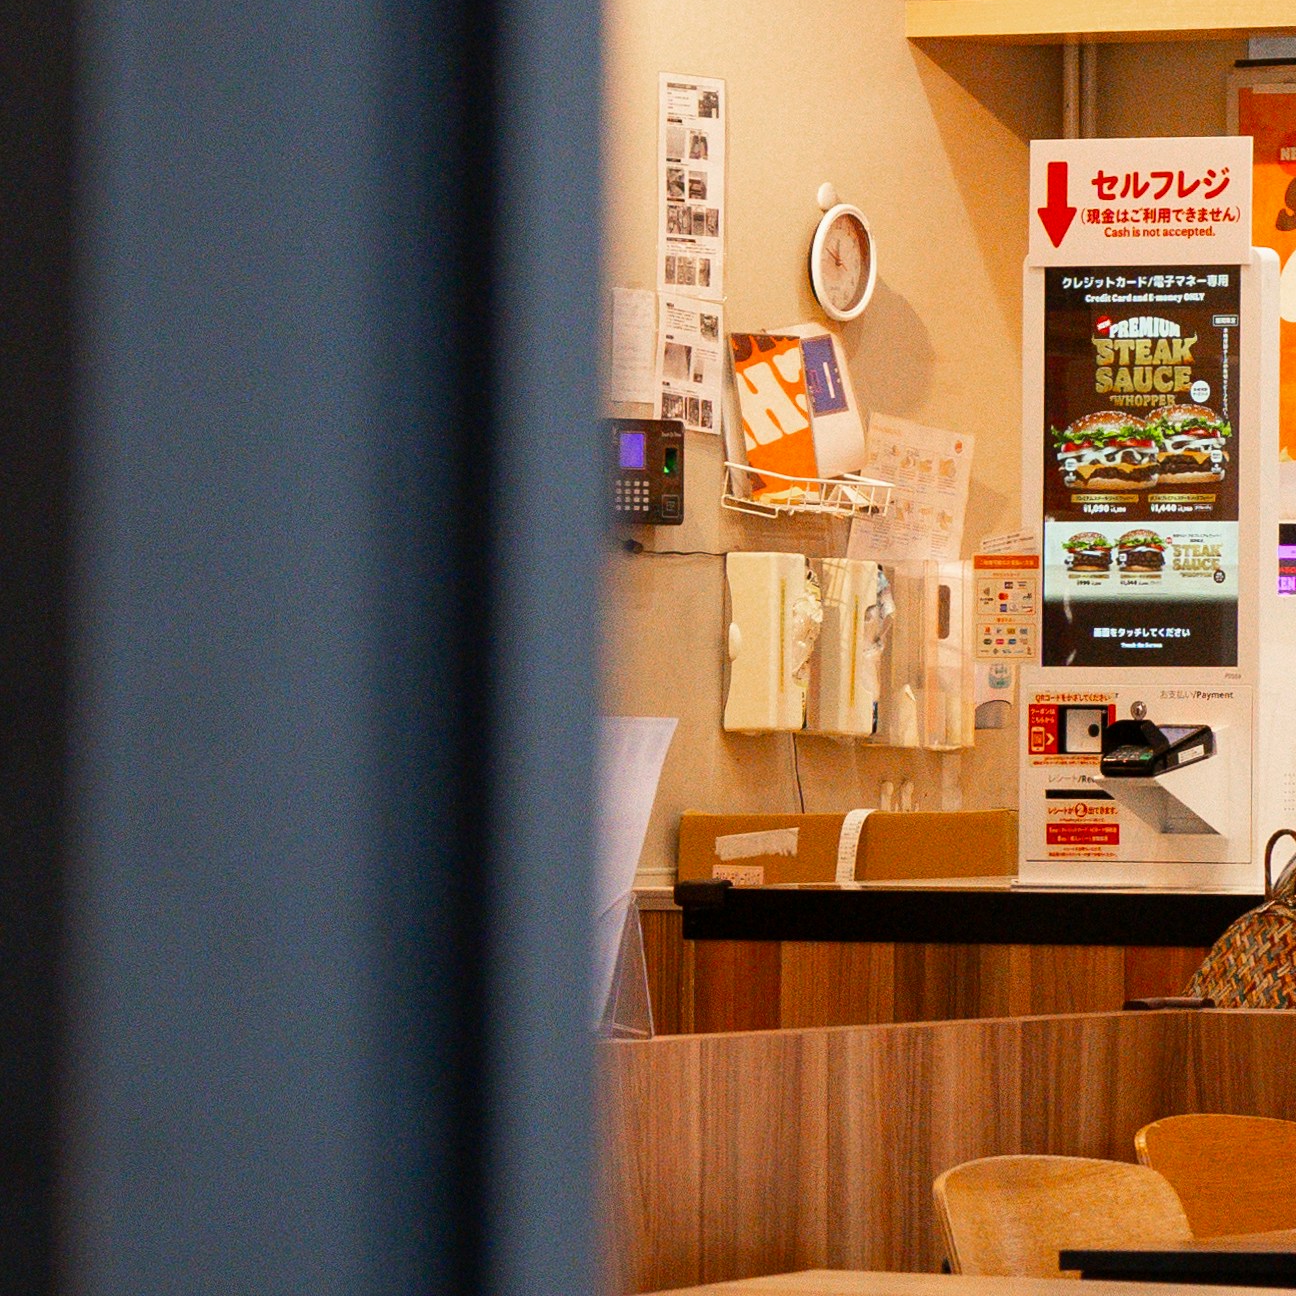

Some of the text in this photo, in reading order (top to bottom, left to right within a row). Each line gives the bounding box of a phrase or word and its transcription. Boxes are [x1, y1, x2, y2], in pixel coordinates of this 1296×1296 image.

[1091, 166, 1231, 201] セルフレジ
[1080, 206, 1241, 224] (現金はご利用できません)
[1104, 226, 1216, 239] Cash is not accepted.
[1061, 274, 1230, 290] クレジットカード/電子マネー専用
[1084, 293, 1111, 303] Credit
[1111, 293, 1132, 303] Card
[1108, 316, 1181, 339] PREMIUM
[1091, 331, 1199, 365] STEAK
[1095, 366, 1193, 394] SAUCE
[1109, 394, 1176, 406] WHOPPER
[1171, 544, 1223, 558] STEAK
[1172, 558, 1221, 571] SAUCE
